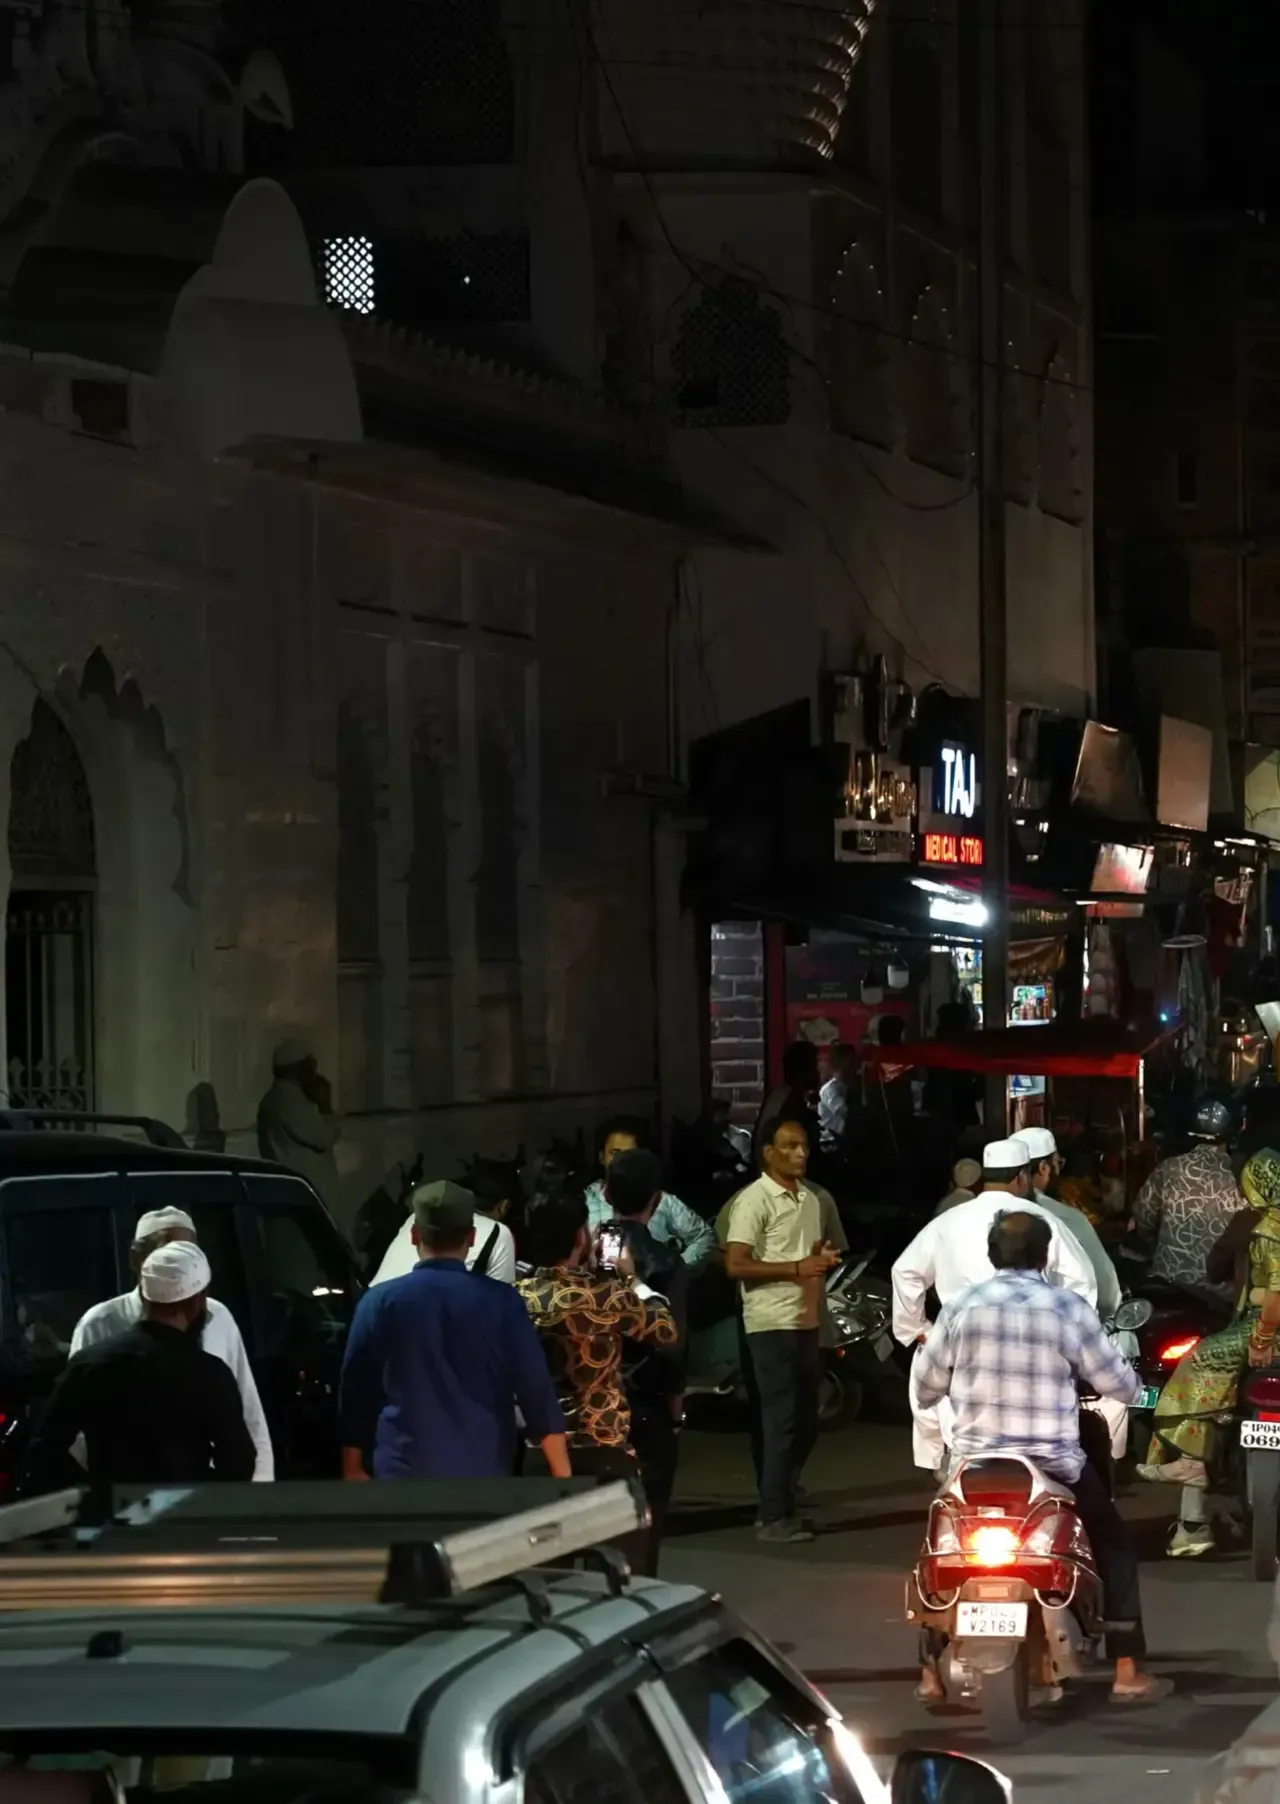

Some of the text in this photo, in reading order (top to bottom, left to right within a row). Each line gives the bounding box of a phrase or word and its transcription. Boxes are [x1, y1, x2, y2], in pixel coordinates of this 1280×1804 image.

[941, 747, 976, 818] TAJ
[925, 834, 958, 863] MEDICAL
[970, 1620, 1017, 1633] V2169
